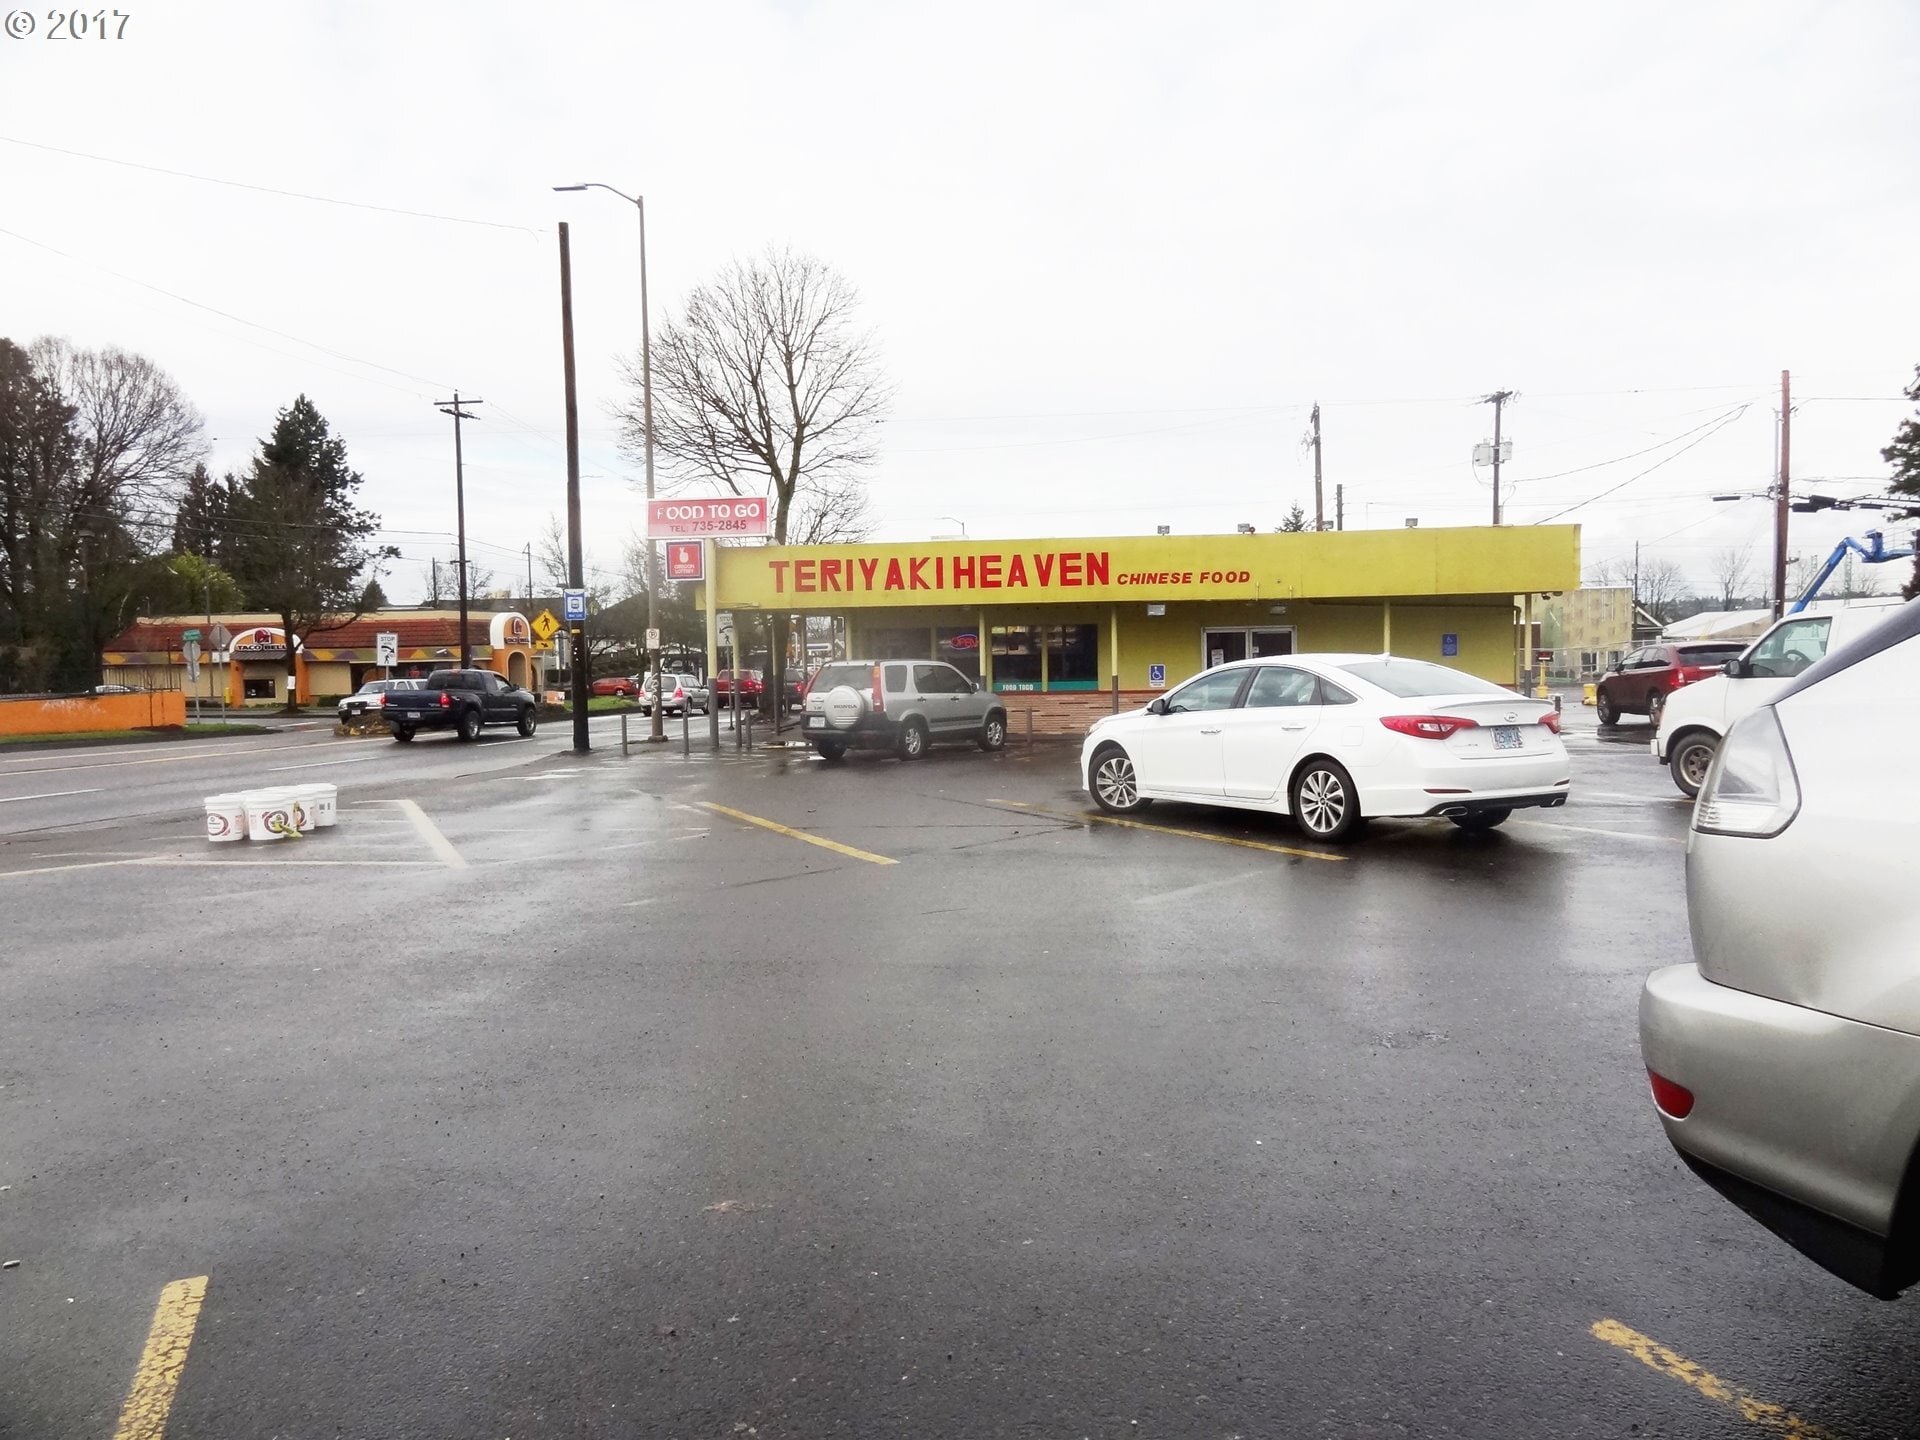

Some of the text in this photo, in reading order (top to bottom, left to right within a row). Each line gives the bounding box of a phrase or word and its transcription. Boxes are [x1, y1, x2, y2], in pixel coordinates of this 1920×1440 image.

[657, 503, 760, 520] FOOD TO GO
[692, 520, 747, 532] 735-2845
[1117, 571, 1250, 585] CHINESE FOOD
